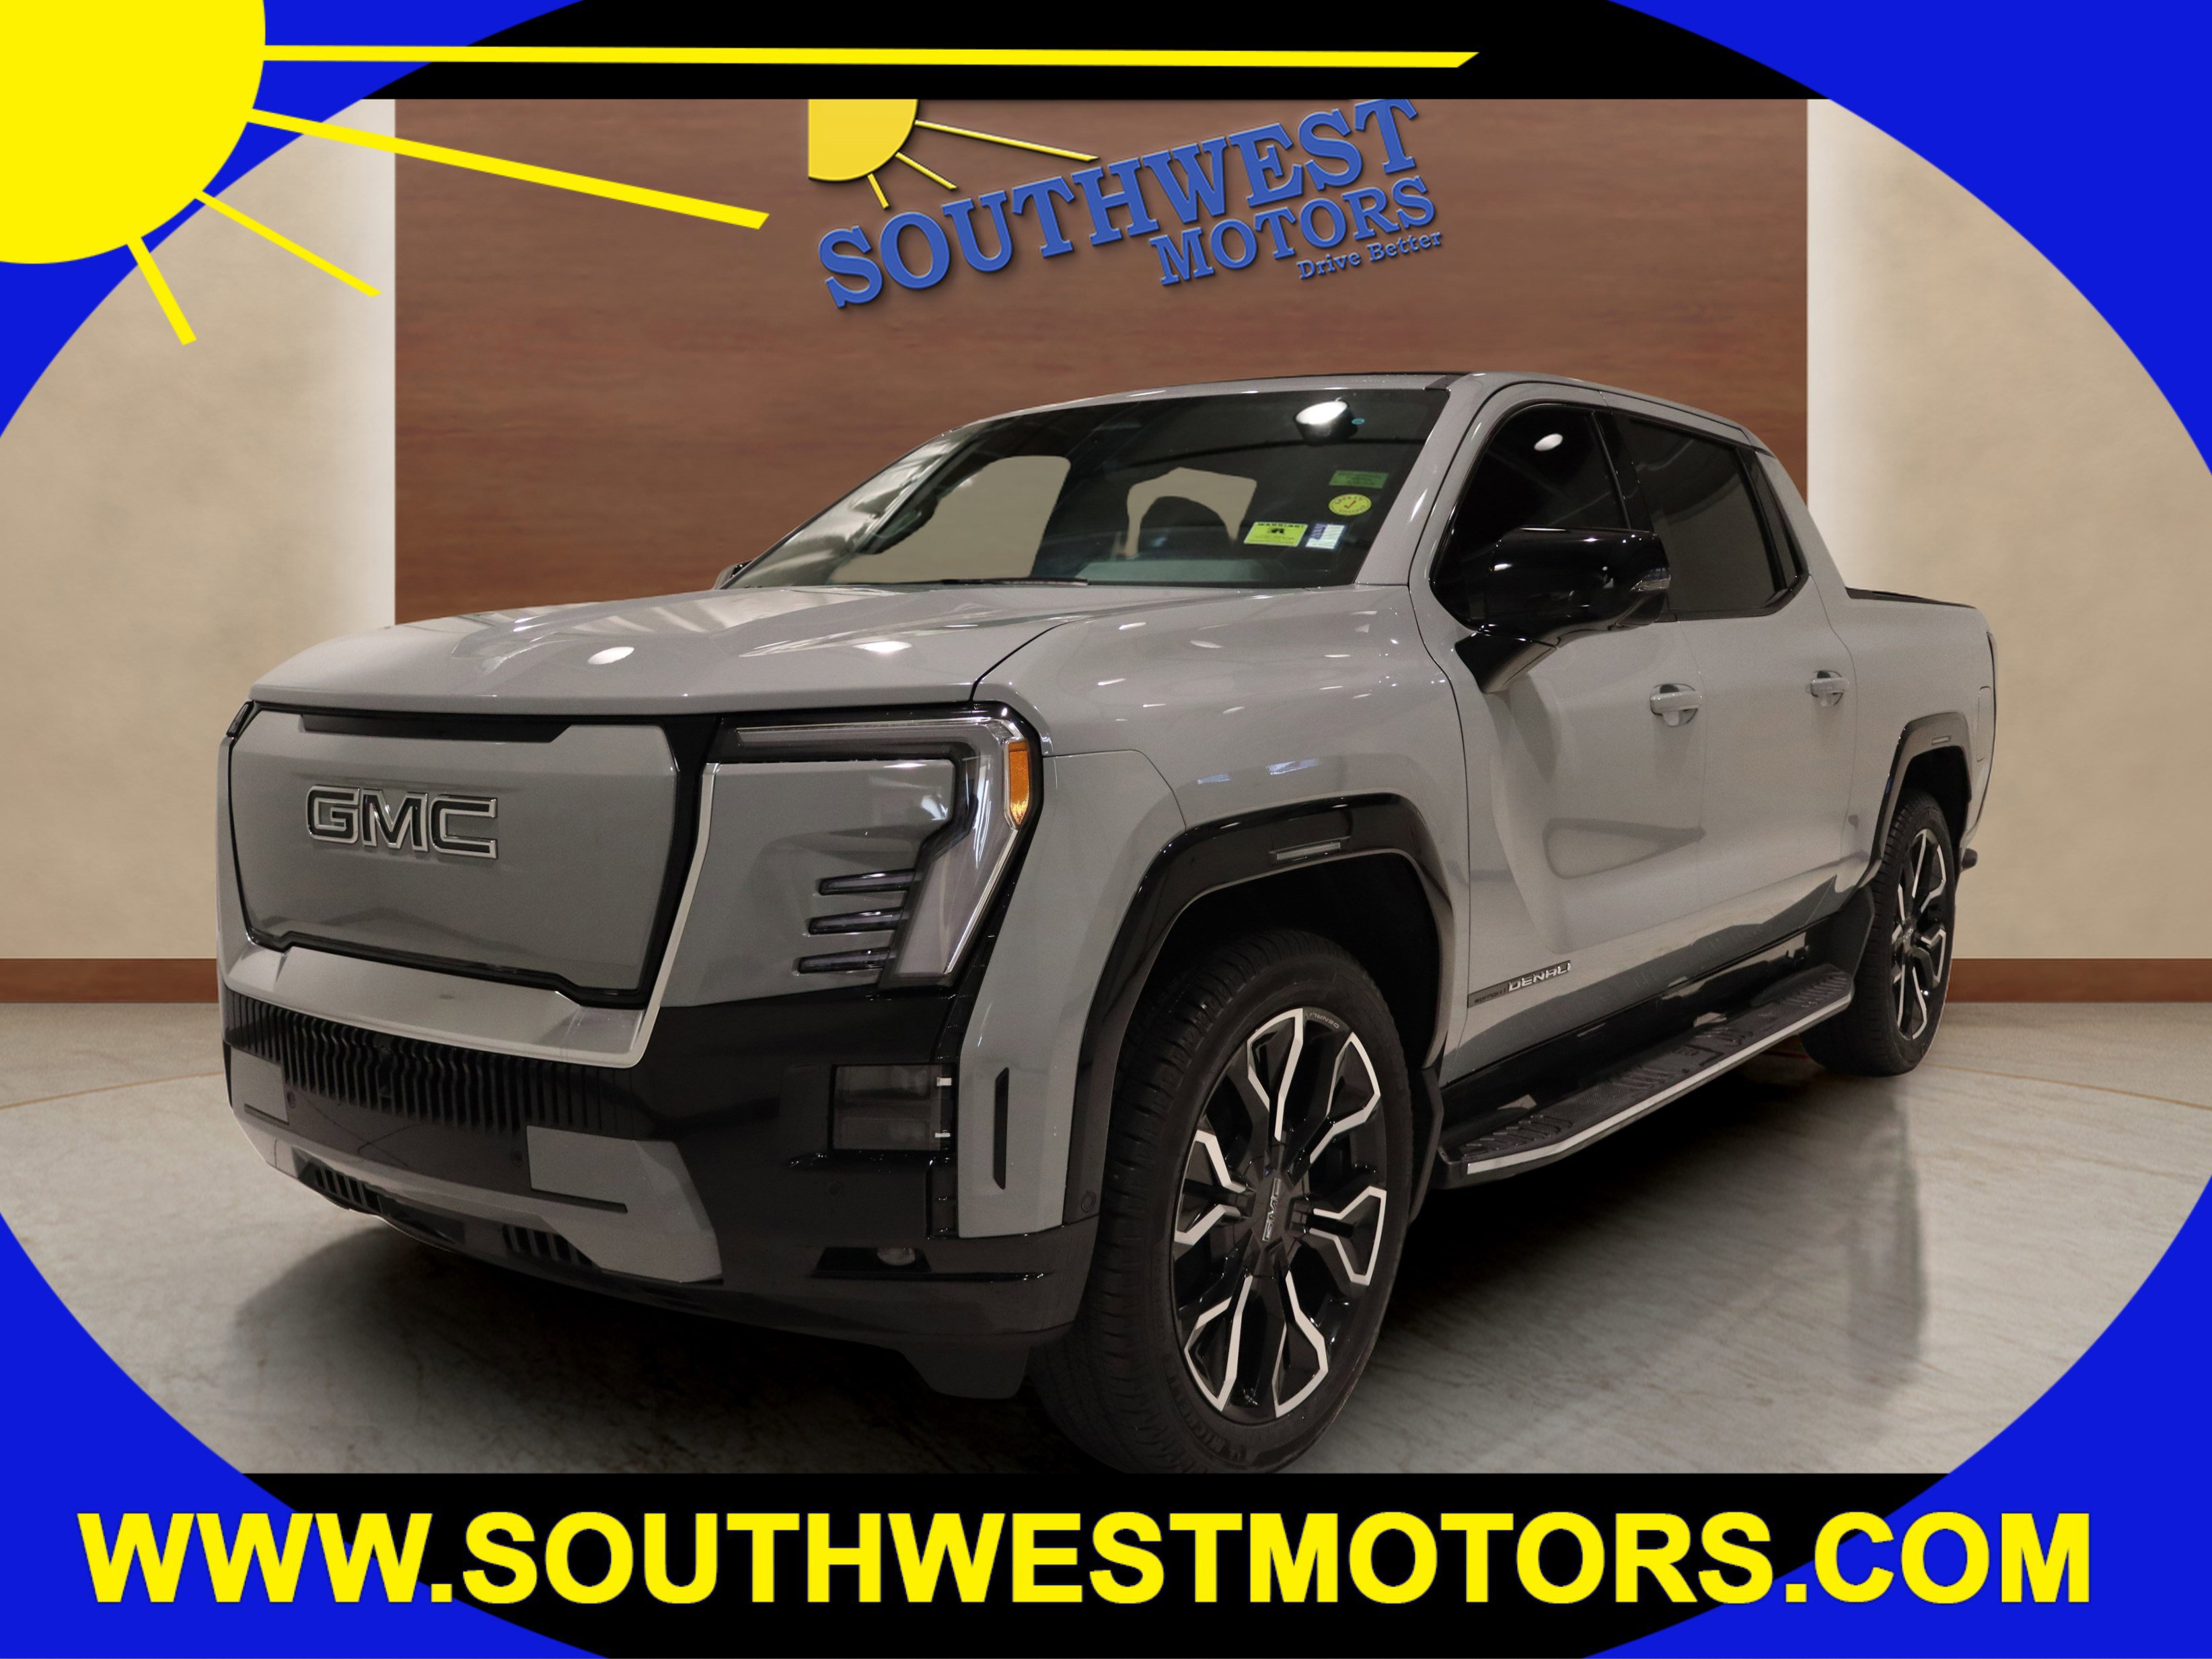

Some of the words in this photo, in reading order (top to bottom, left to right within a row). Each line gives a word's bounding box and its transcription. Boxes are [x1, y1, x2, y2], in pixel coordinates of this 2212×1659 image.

[819, 100, 1417, 308] SOUTHWEST
[1149, 176, 1435, 285] MOTORS
[1297, 253, 1362, 279] Drive
[1367, 232, 1442, 262] Better
[306, 784, 498, 859] GMC
[1508, 962, 1571, 992] DENALI
[1309, 1012, 1340, 1029] DENALI
